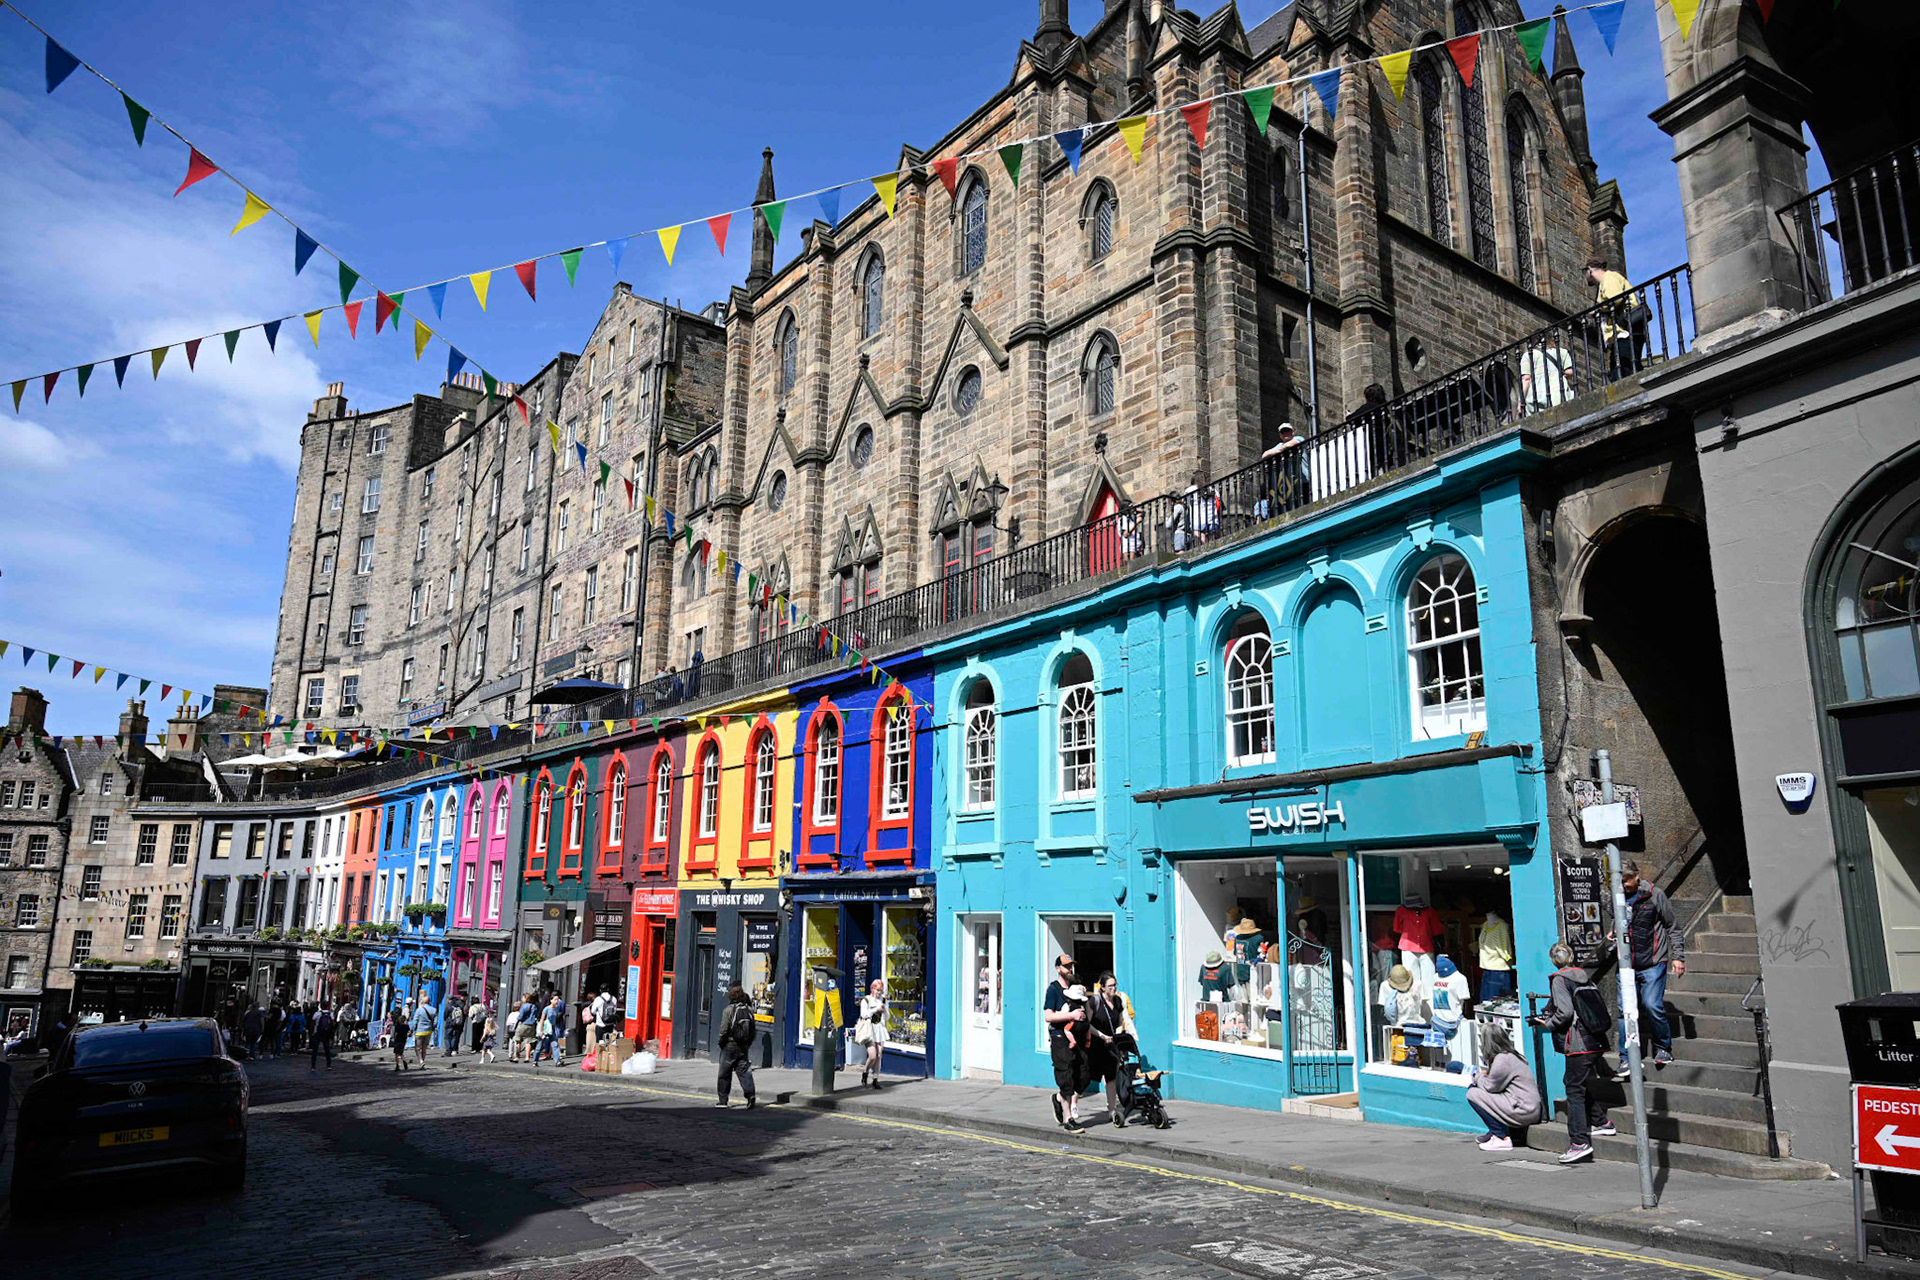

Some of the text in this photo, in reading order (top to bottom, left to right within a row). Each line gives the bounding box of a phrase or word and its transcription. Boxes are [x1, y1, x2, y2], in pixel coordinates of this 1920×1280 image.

[1779, 776, 1807, 784] IMMS
[1246, 800, 1345, 829] SWISH
[1566, 867, 1592, 876] SCOTTS
[696, 892, 765, 906] THE WHISKY SHOP
[1878, 1050, 1914, 1062] Litter
[1864, 1099, 1920, 1115] PEDEST
